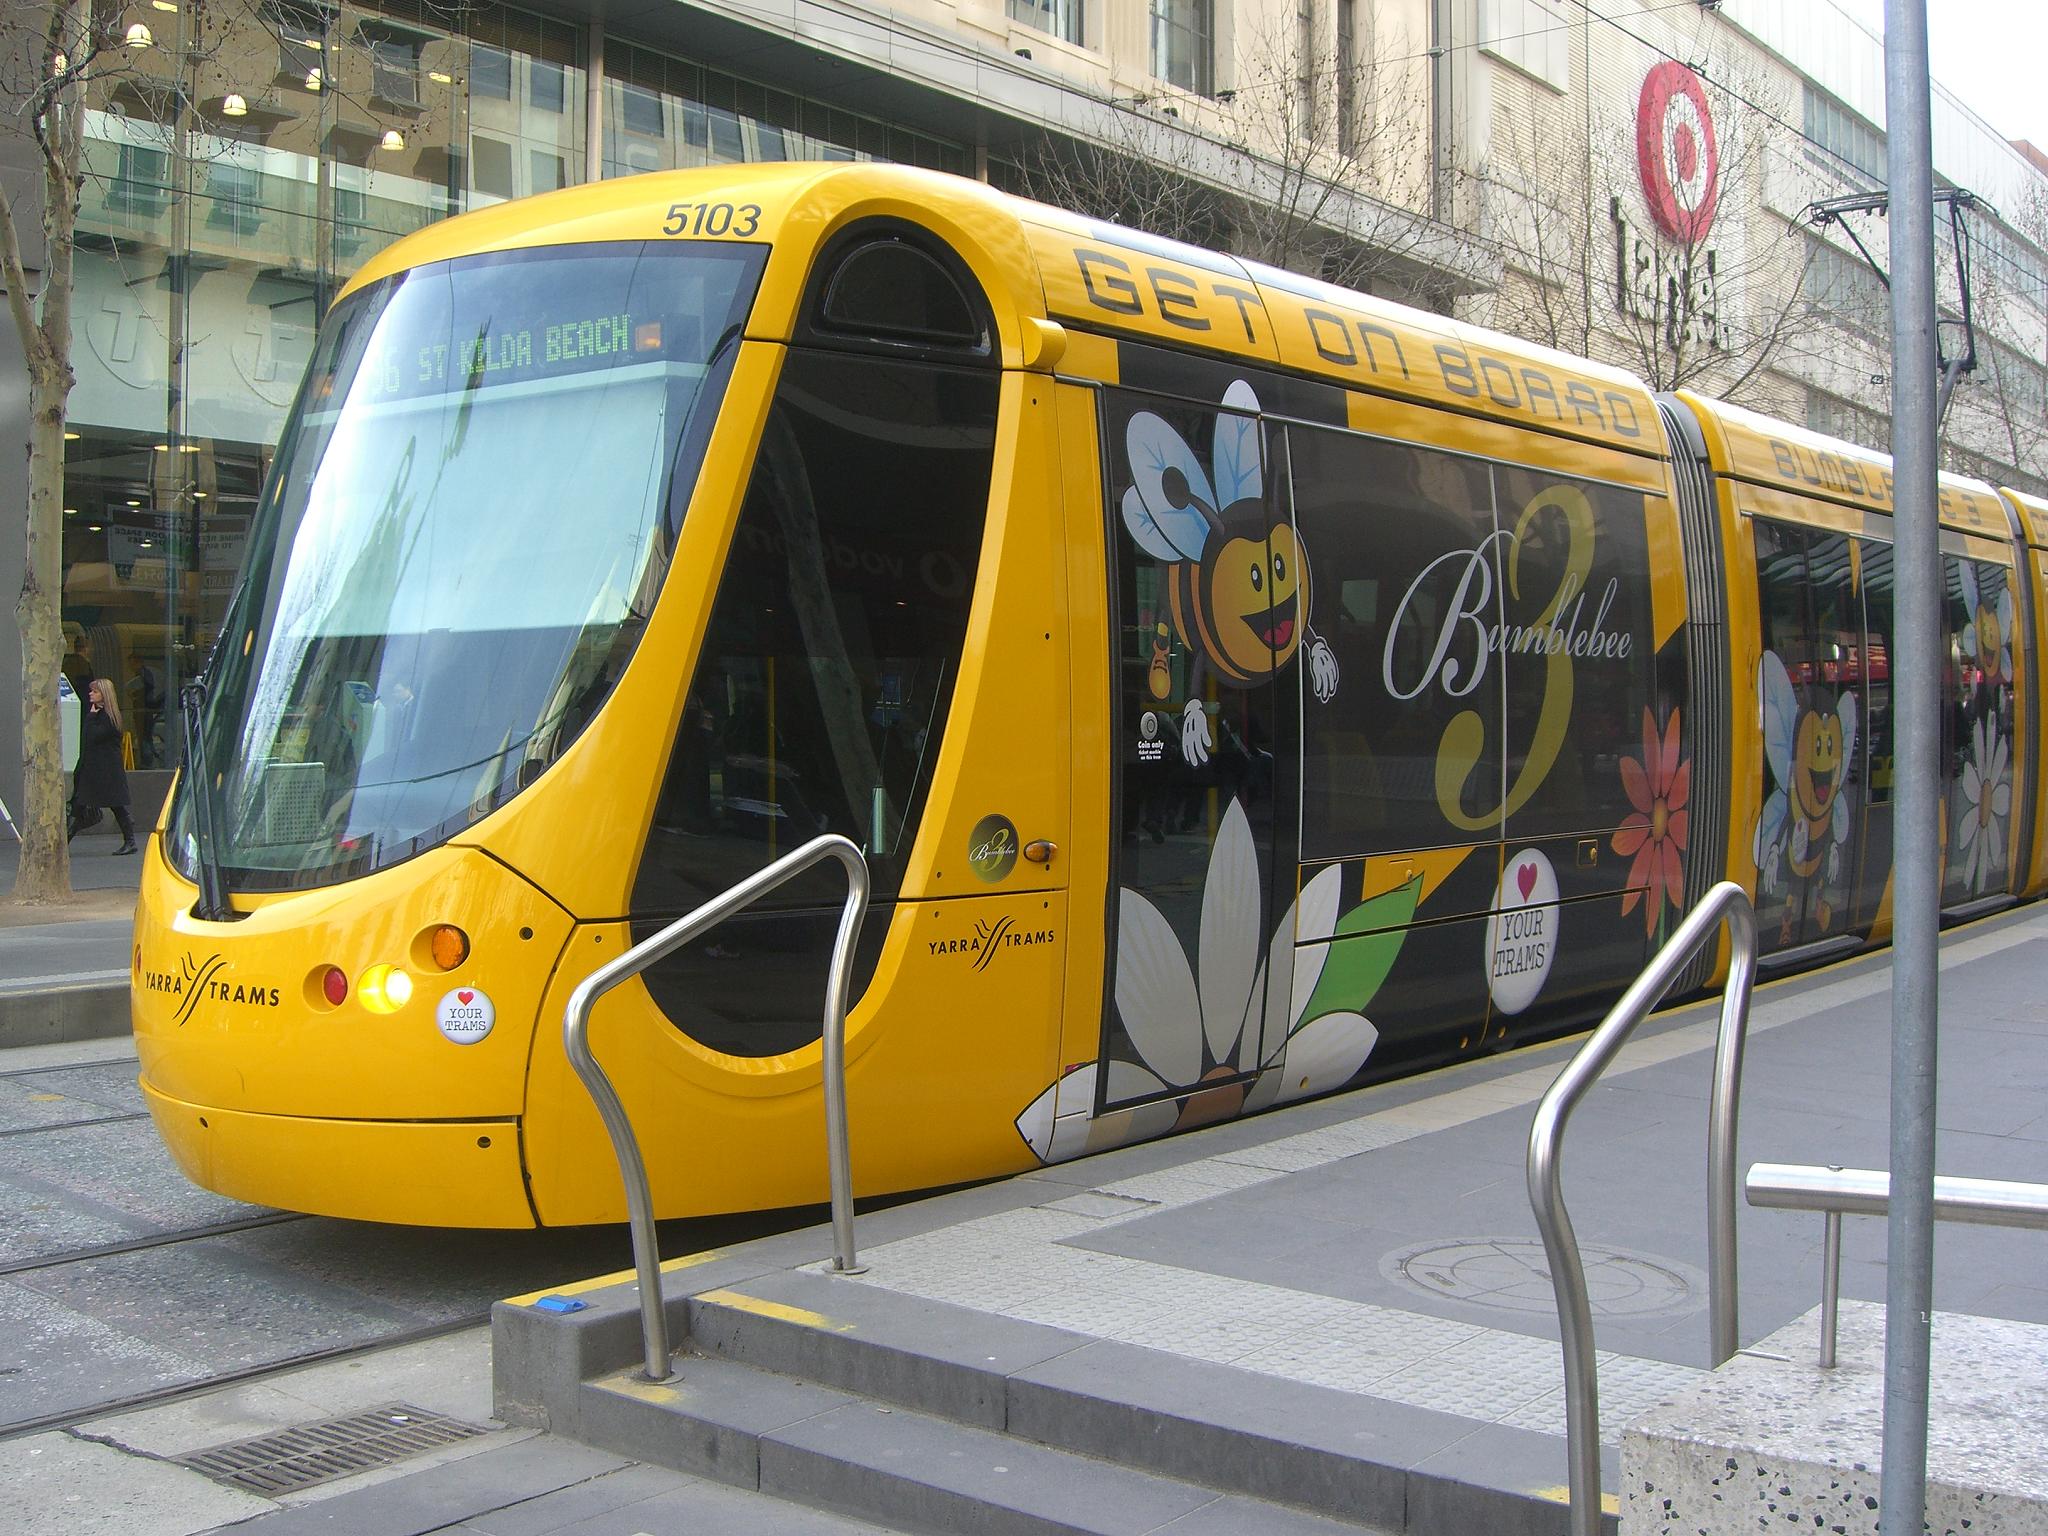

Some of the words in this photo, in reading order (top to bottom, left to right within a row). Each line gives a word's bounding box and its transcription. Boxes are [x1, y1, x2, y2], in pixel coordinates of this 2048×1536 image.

[663, 203, 761, 237] 5103
[418, 343, 447, 382] ST
[458, 329, 532, 376] KILDA
[545, 313, 630, 363] BEACH
[1073, 248, 1262, 344] GET
[1304, 308, 1410, 381] ON
[1433, 344, 1641, 437] BOARD
[1383, 529, 1633, 700] Bumblebee
[1435, 484, 1596, 832] 3
[929, 937, 980, 955] YARRA
[1005, 930, 1055, 947] TRAMS
[1503, 909, 1544, 942] YOUR
[145, 971, 182, 995] YARRA
[209, 981, 280, 1007] TRAMS
[444, 1020, 487, 1031] TRAMS
[449, 1008, 483, 1019] YOUR
